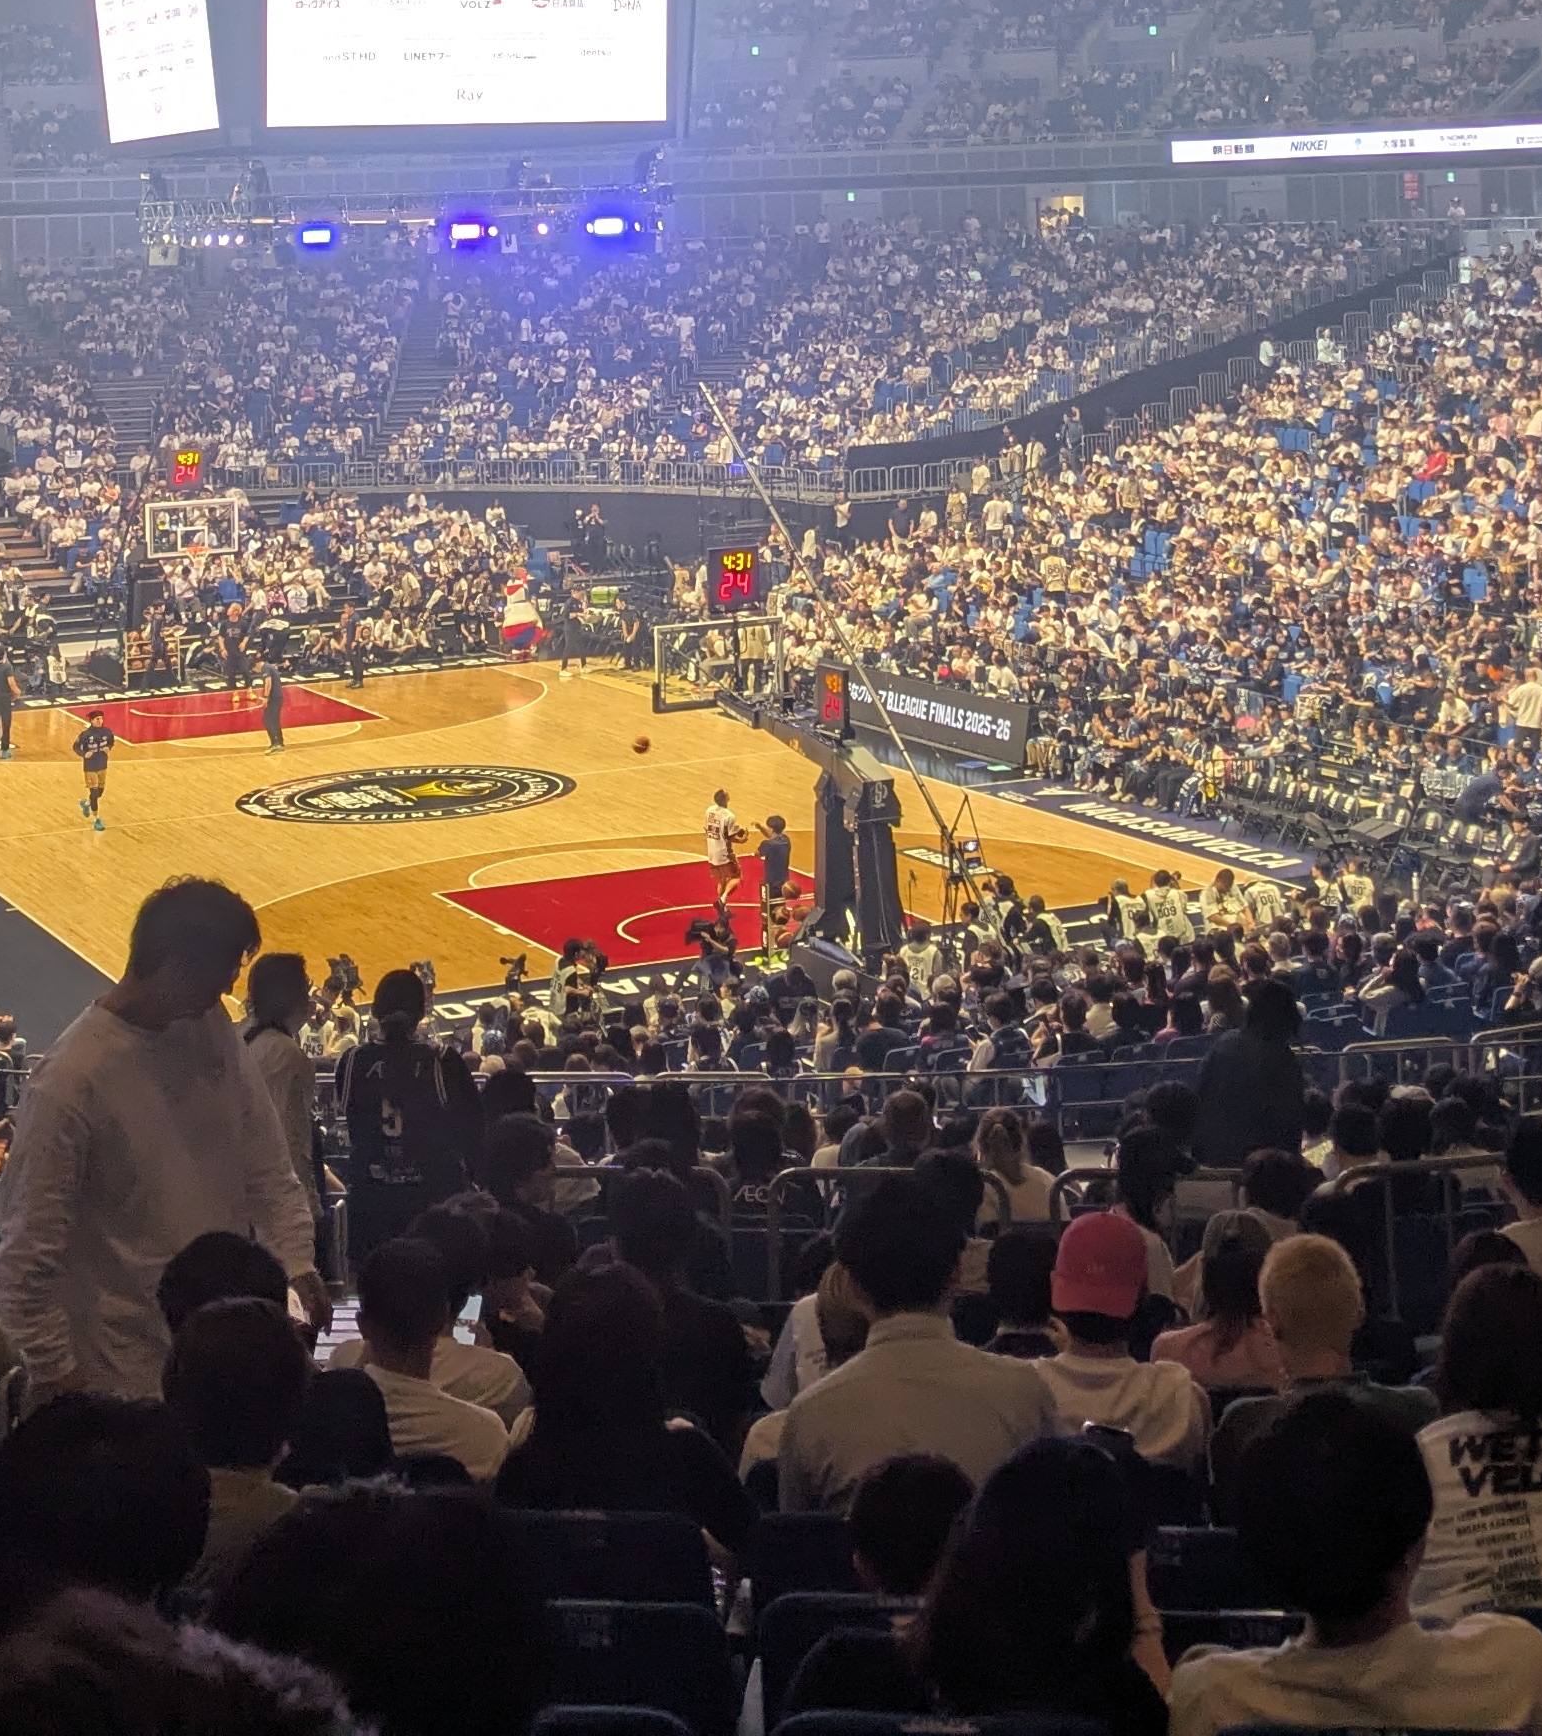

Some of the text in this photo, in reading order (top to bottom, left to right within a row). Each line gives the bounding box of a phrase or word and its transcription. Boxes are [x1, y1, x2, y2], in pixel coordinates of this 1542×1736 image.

[460, 0, 491, 9] VOLZ
[403, 52, 452, 61] LINEヤフー
[457, 89, 483, 102] Ray
[1290, 139, 1328, 152] NIKKEI
[177, 452, 199, 465] 4:31
[175, 465, 197, 483] 24
[722, 552, 752, 571] 4:31
[719, 572, 749, 599] 24
[25, 685, 198, 707] B.LEAGUE
[822, 692, 841, 720] 24
[887, 691, 927, 721] B.LEAGUE
[928, 701, 965, 730] FINALS
[965, 710, 1011, 741] 2025-26
[1059, 801, 1303, 869] NAGASAKI VELCA
[1449, 1432, 1514, 1467] WE
